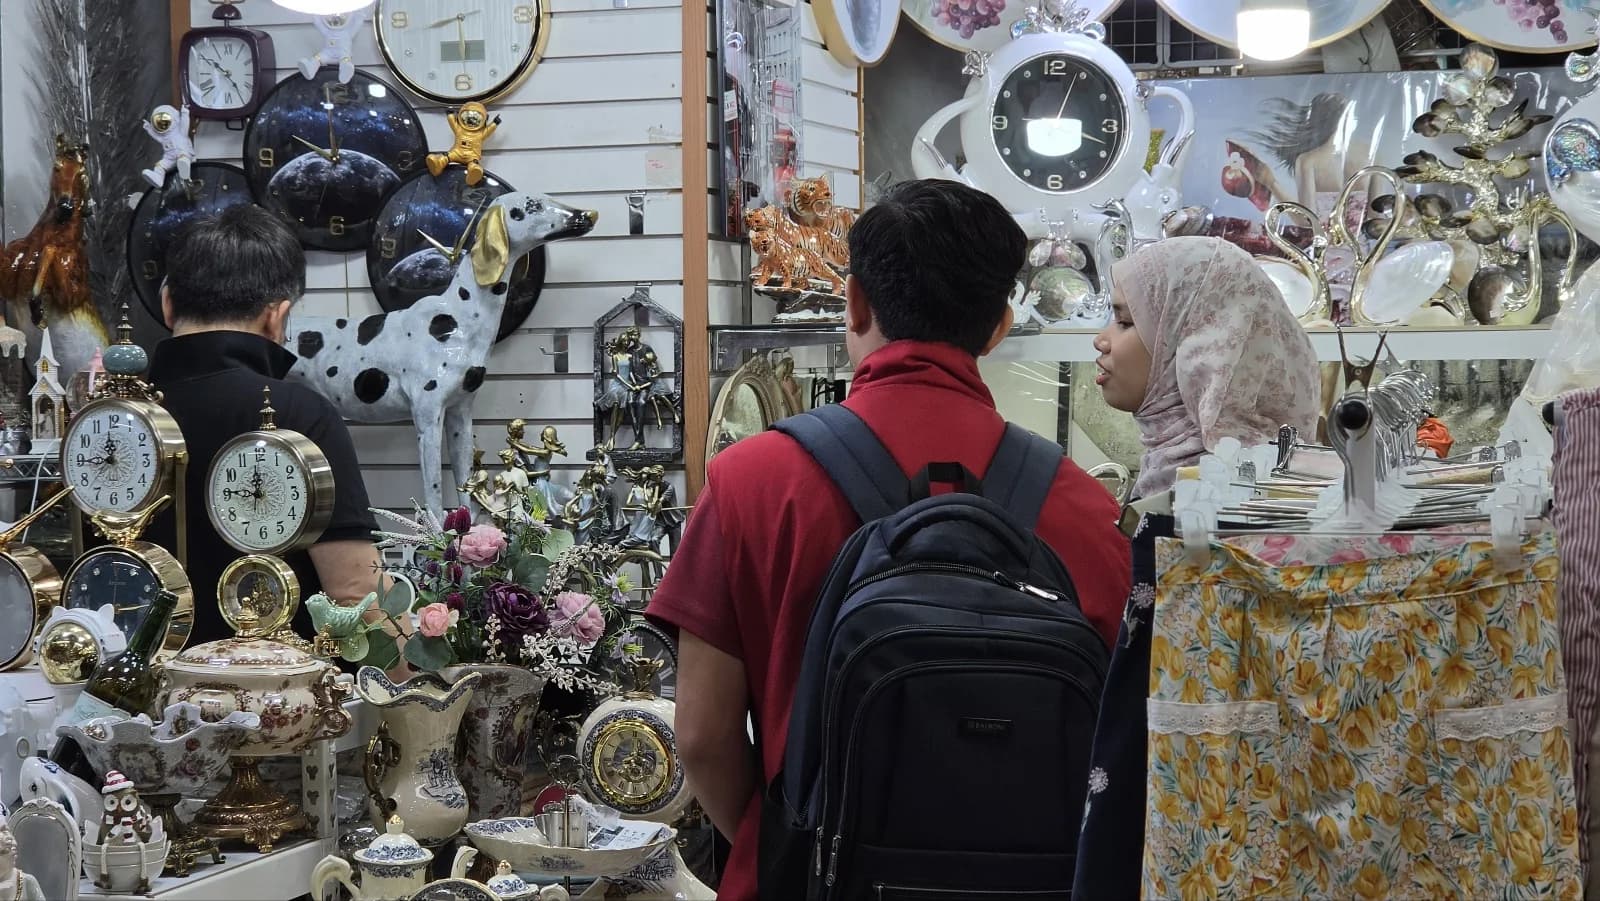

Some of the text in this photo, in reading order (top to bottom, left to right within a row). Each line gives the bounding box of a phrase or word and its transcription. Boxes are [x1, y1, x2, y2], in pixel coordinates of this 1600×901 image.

[392, 12, 408, 28] 9
[1044, 60, 1067, 76] 12
[455, 74, 472, 91] 6
[992, 116, 1008, 130] 9
[1102, 118, 1118, 134] 3
[259, 148, 274, 168] 9
[1047, 174, 1063, 190] 6
[330, 216, 344, 235] 6
[93, 420, 100, 434] 11
[109, 414, 120, 429] 12
[80, 434, 90, 448] 10
[138, 432, 146, 447] 2
[76, 454, 85, 467] 9
[142, 454, 150, 468] 3
[238, 453, 246, 467] 11
[81, 472, 88, 486] 8
[226, 468, 236, 482] 10
[286, 465, 294, 479] 2
[138, 473, 147, 487] 4
[94, 487, 101, 500] 7
[110, 492, 118, 506] 6
[126, 488, 134, 500] 5
[223, 488, 232, 501] 9
[290, 486, 299, 500] 3
[228, 507, 236, 521] 8
[288, 506, 296, 520] 4
[242, 521, 250, 535] 7
[260, 526, 268, 540] 6
[276, 521, 284, 534] 5
